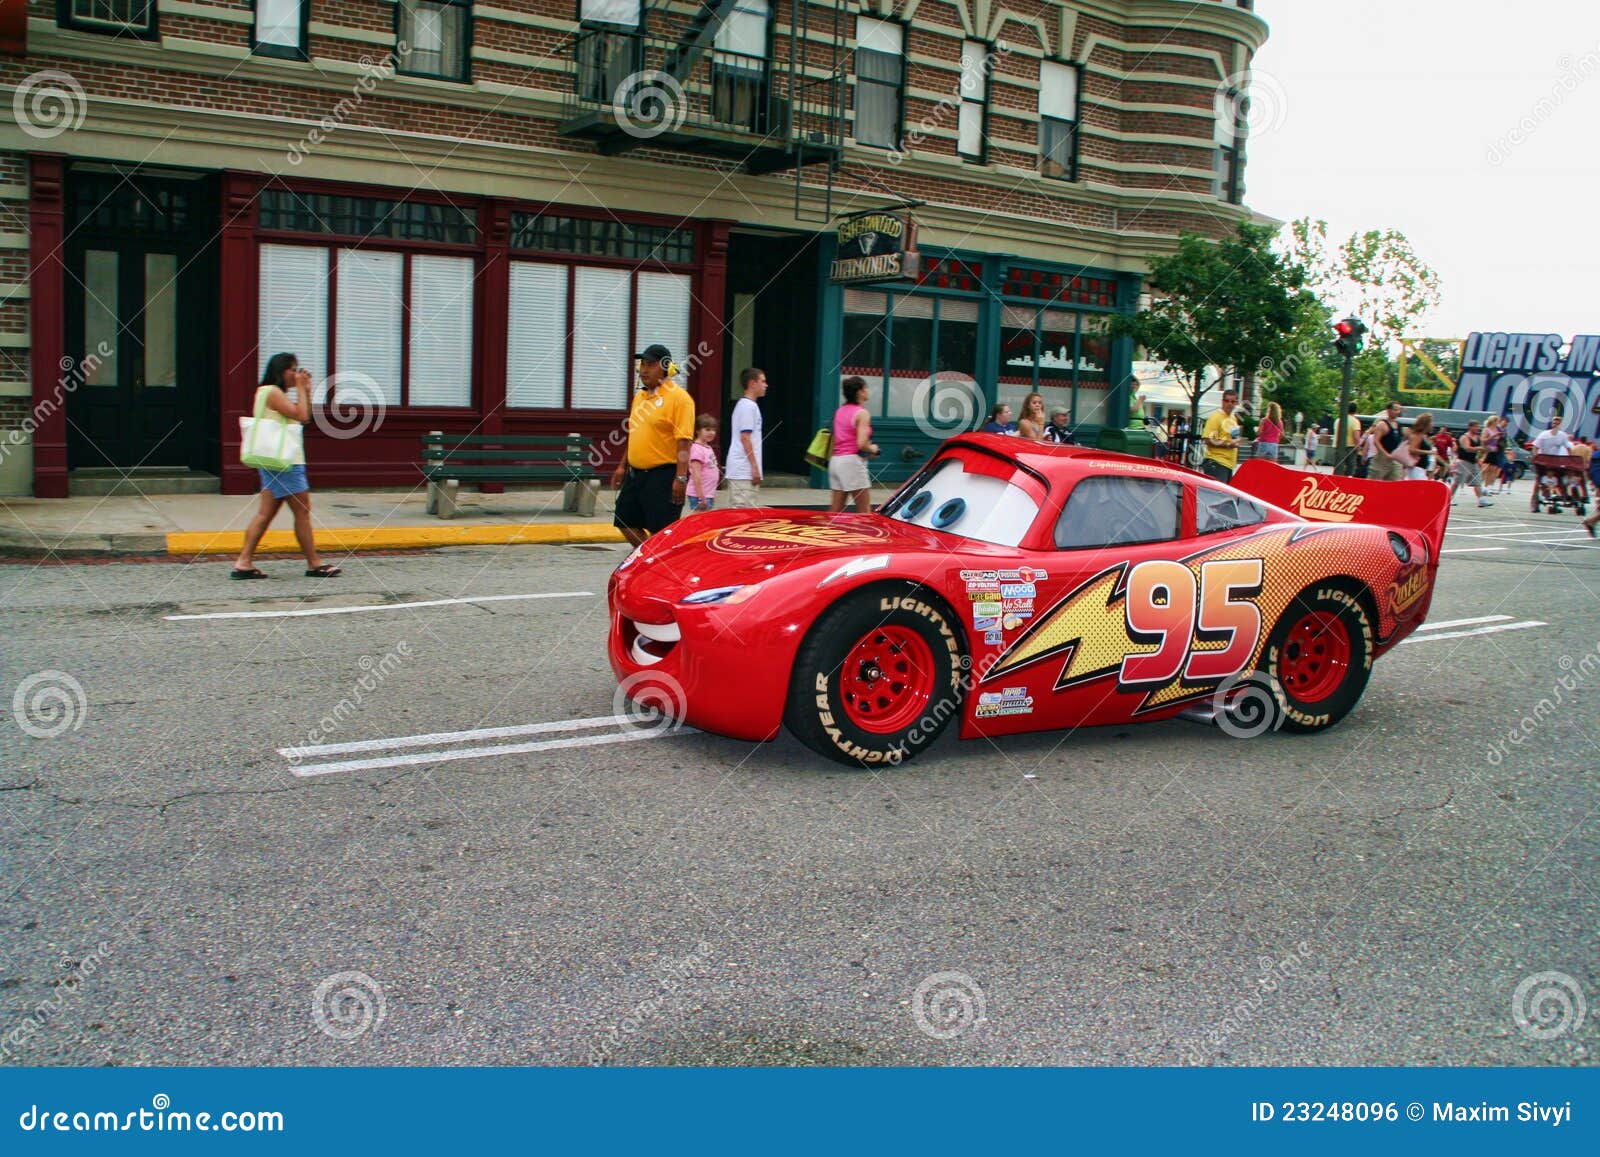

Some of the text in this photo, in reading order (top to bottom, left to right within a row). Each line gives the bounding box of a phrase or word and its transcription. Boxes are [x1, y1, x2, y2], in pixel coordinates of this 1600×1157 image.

[1566, 335, 1600, 373] M
[880, 596, 960, 689] LIGHTYEAR
[1119, 559, 1263, 684] 95
[815, 671, 903, 763] LIGHTYEAR
